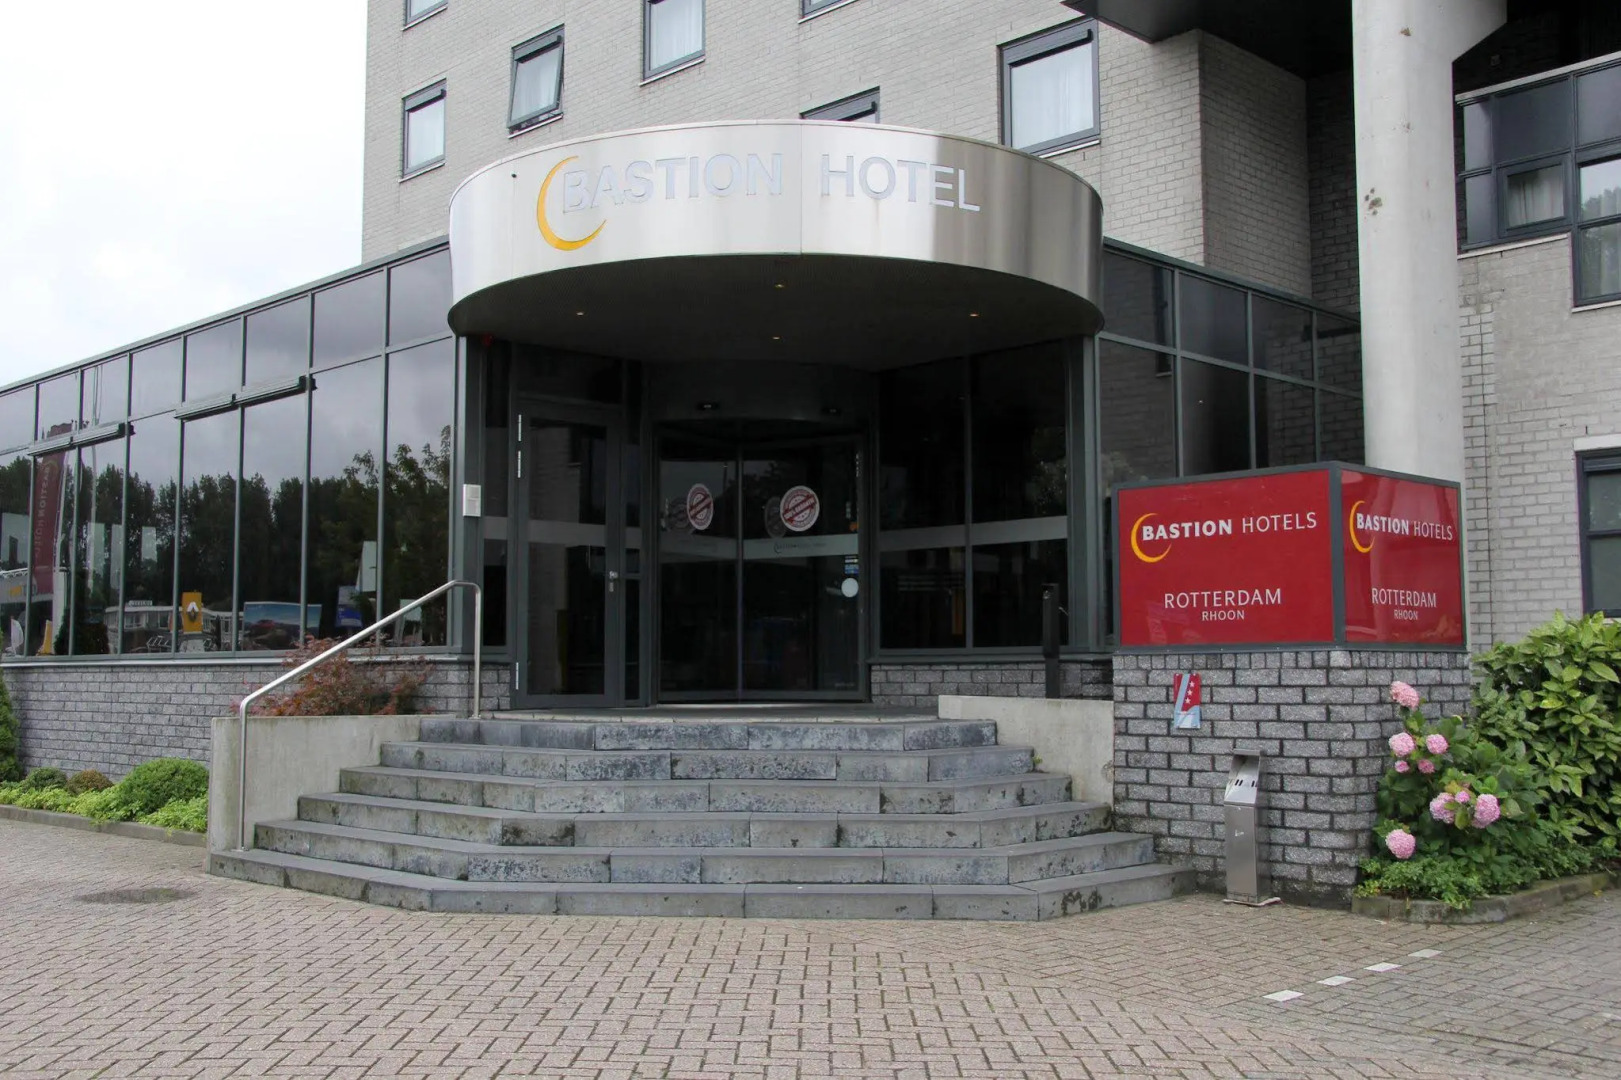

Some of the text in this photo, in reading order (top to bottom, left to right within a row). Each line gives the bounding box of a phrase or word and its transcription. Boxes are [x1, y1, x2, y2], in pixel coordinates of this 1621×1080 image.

[563, 153, 981, 214] BASTION HOTEL
[1142, 512, 1317, 541] BASTION HOTELS
[1356, 513, 1453, 541] BASTION HOTELS
[1164, 588, 1282, 609] ROTTERDAM
[1371, 587, 1437, 608] ROTTERDAM
[1201, 610, 1245, 621] RHOON
[1393, 609, 1418, 620] RHOON
